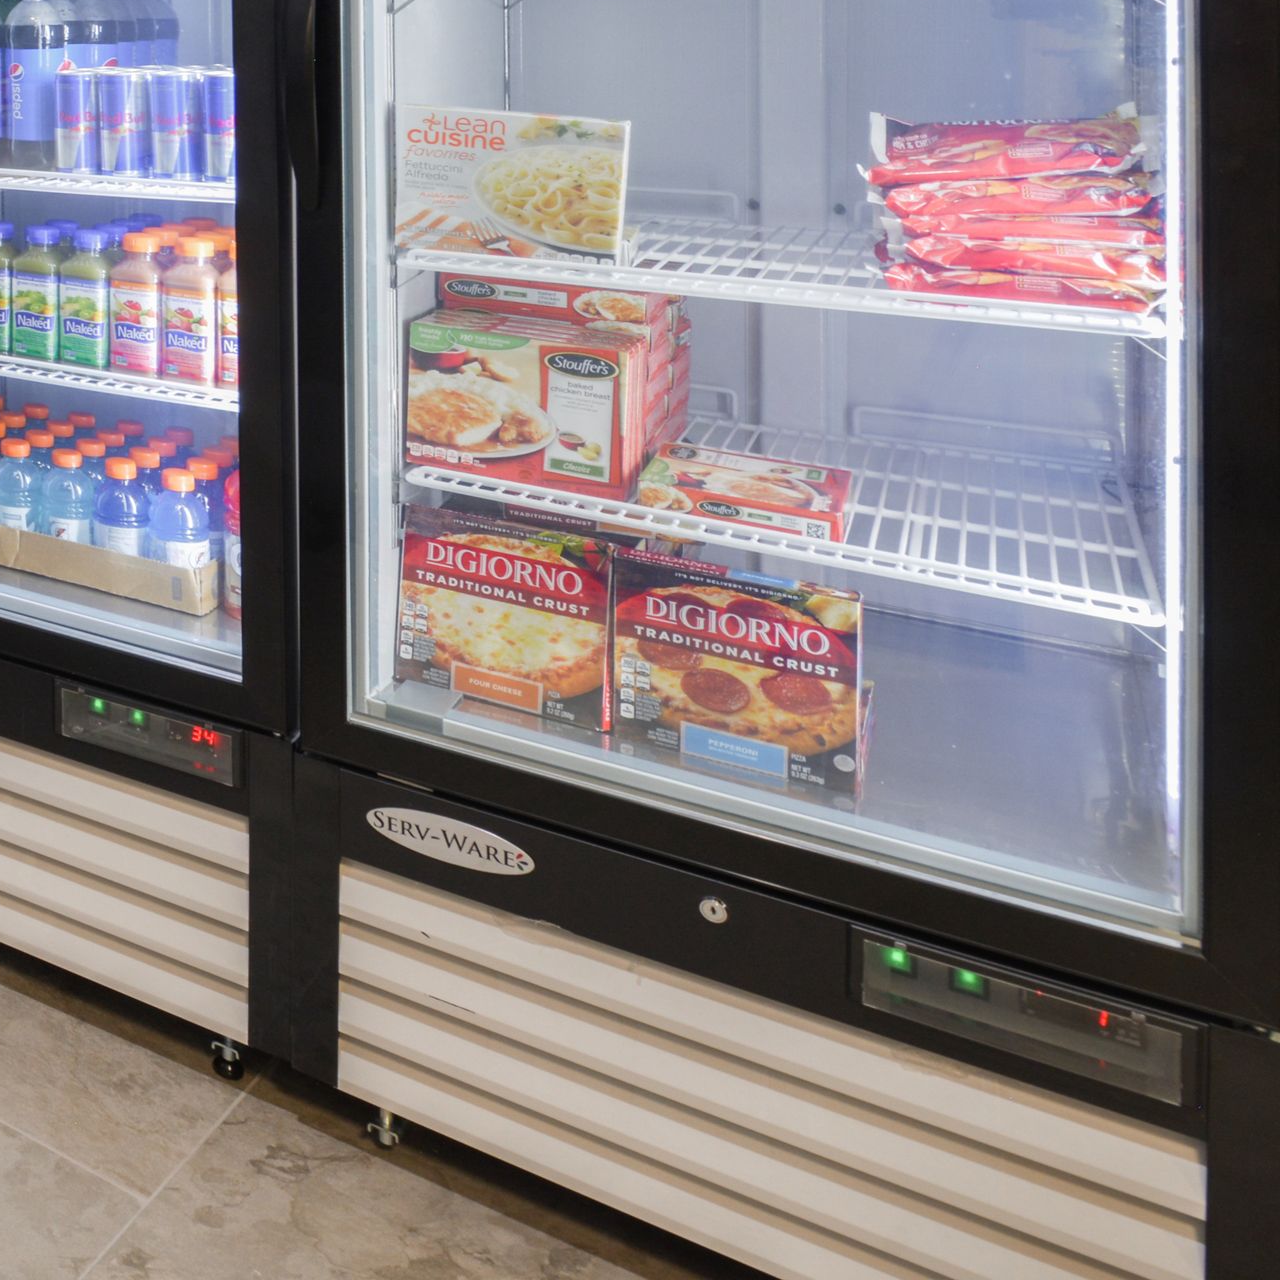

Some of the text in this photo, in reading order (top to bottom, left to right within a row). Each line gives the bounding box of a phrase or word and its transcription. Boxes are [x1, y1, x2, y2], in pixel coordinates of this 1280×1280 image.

[12, 82, 23, 119] pepsi
[403, 144, 477, 162] favorites
[404, 159, 464, 174] Fettuccini
[404, 169, 449, 182] Alfredo
[450, 281, 491, 296] Stouffer's
[17, 313, 52, 330] Naked
[66, 320, 101, 337] Naked
[117, 325, 154, 341] Naked
[167, 334, 206, 350] Naked
[553, 354, 609, 376] Stouffer's
[550, 385, 611, 401] chicken breast
[567, 380, 594, 391] baked
[509, 509, 592, 527] TRADITIONAL CRUST
[702, 502, 739, 517] Stouffer's
[426, 541, 583, 596] DIGIORNO
[415, 569, 590, 617] TRADITIONAL CRUST
[645, 595, 831, 656] DIGIORNO
[634, 624, 840, 678] TRADITIONAL CRUST
[468, 677, 524, 697] FOUR CHEESE
[191, 725, 216, 746] 34
[707, 738, 759, 757] PEPPERONI
[373, 810, 516, 868] SERV-WARE
